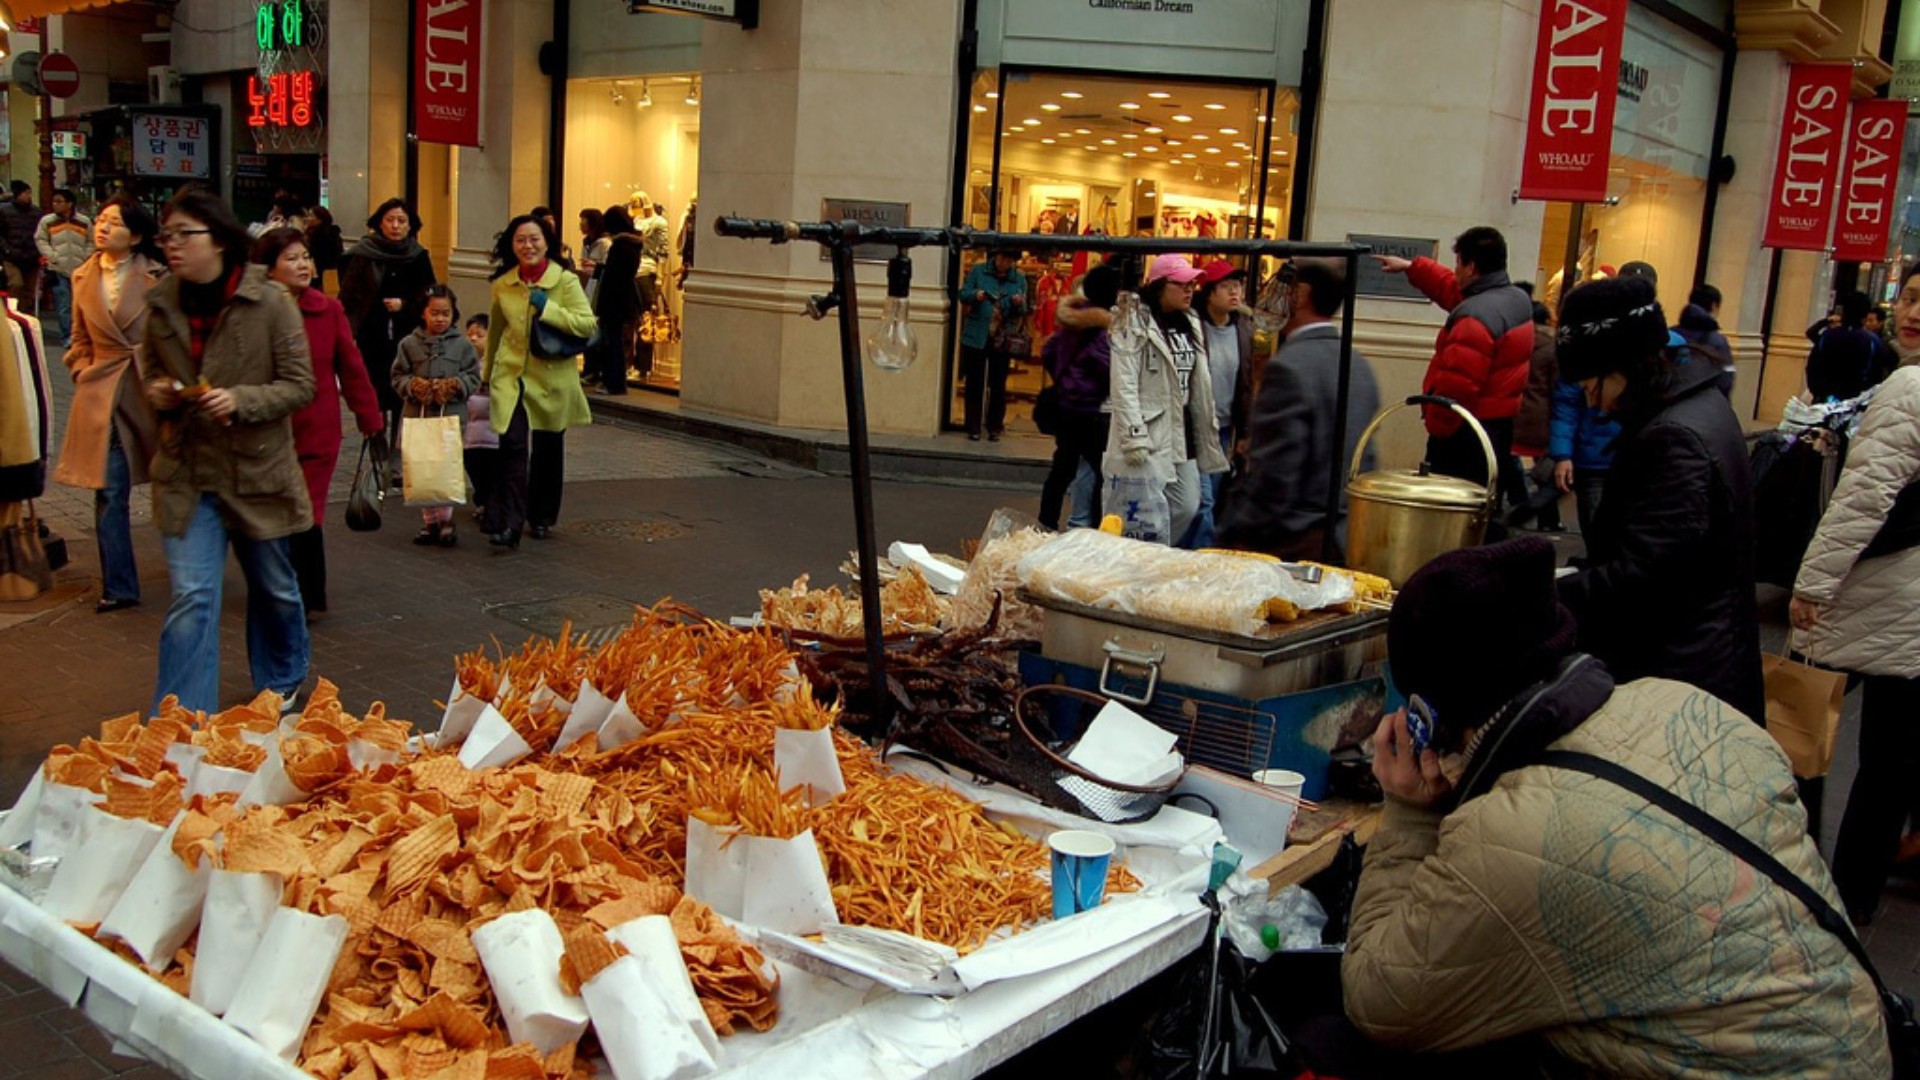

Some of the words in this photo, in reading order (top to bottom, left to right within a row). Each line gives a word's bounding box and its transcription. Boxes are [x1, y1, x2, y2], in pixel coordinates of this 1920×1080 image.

[1154, 0, 1193, 13] Dream
[425, 0, 469, 93] ALE
[1541, 0, 1608, 137] ALE
[144, 117, 201, 139] 상품권
[248, 70, 312, 126] 노래방
[149, 139, 195, 156] 담배
[1780, 83, 1838, 207] SALE
[1846, 117, 1895, 224] SALE
